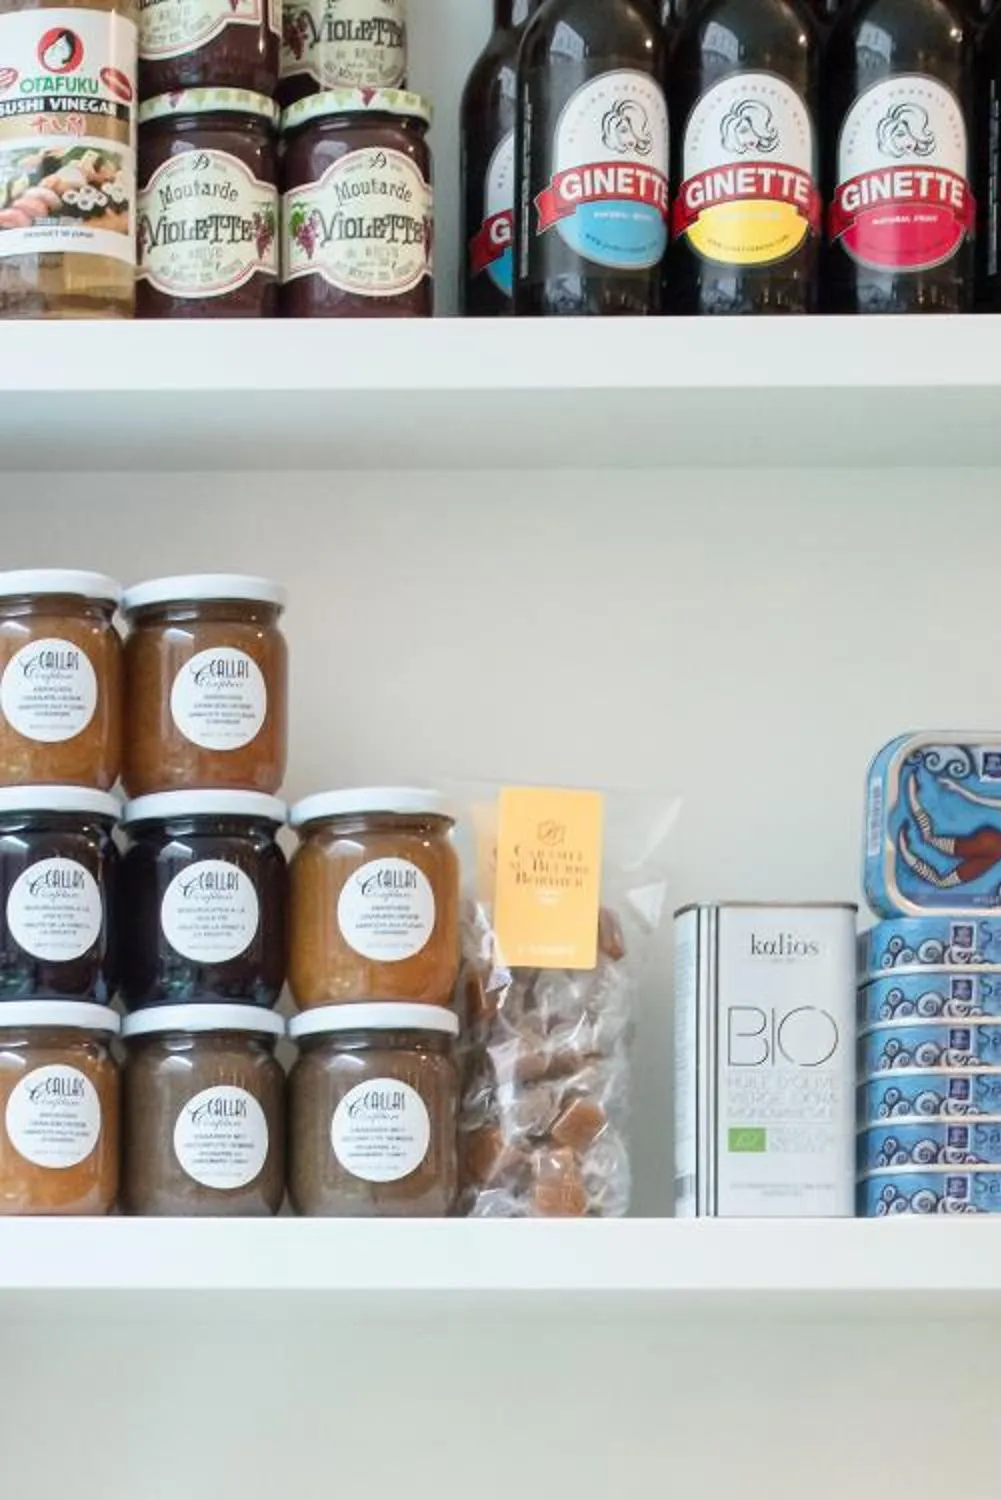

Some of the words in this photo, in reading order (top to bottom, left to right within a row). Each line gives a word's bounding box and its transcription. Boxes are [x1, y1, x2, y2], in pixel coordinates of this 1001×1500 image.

[20, 75, 99, 94] OTAFUKU
[51, 97, 117, 115] VINEGAR
[158, 179, 240, 212] Moutarde
[334, 178, 414, 211] Moutarde
[686, 168, 810, 209] GINETTE
[841, 171, 965, 212] GINETTE
[750, 933, 820, 957] kalios
[727, 1005, 839, 1067] BIO
